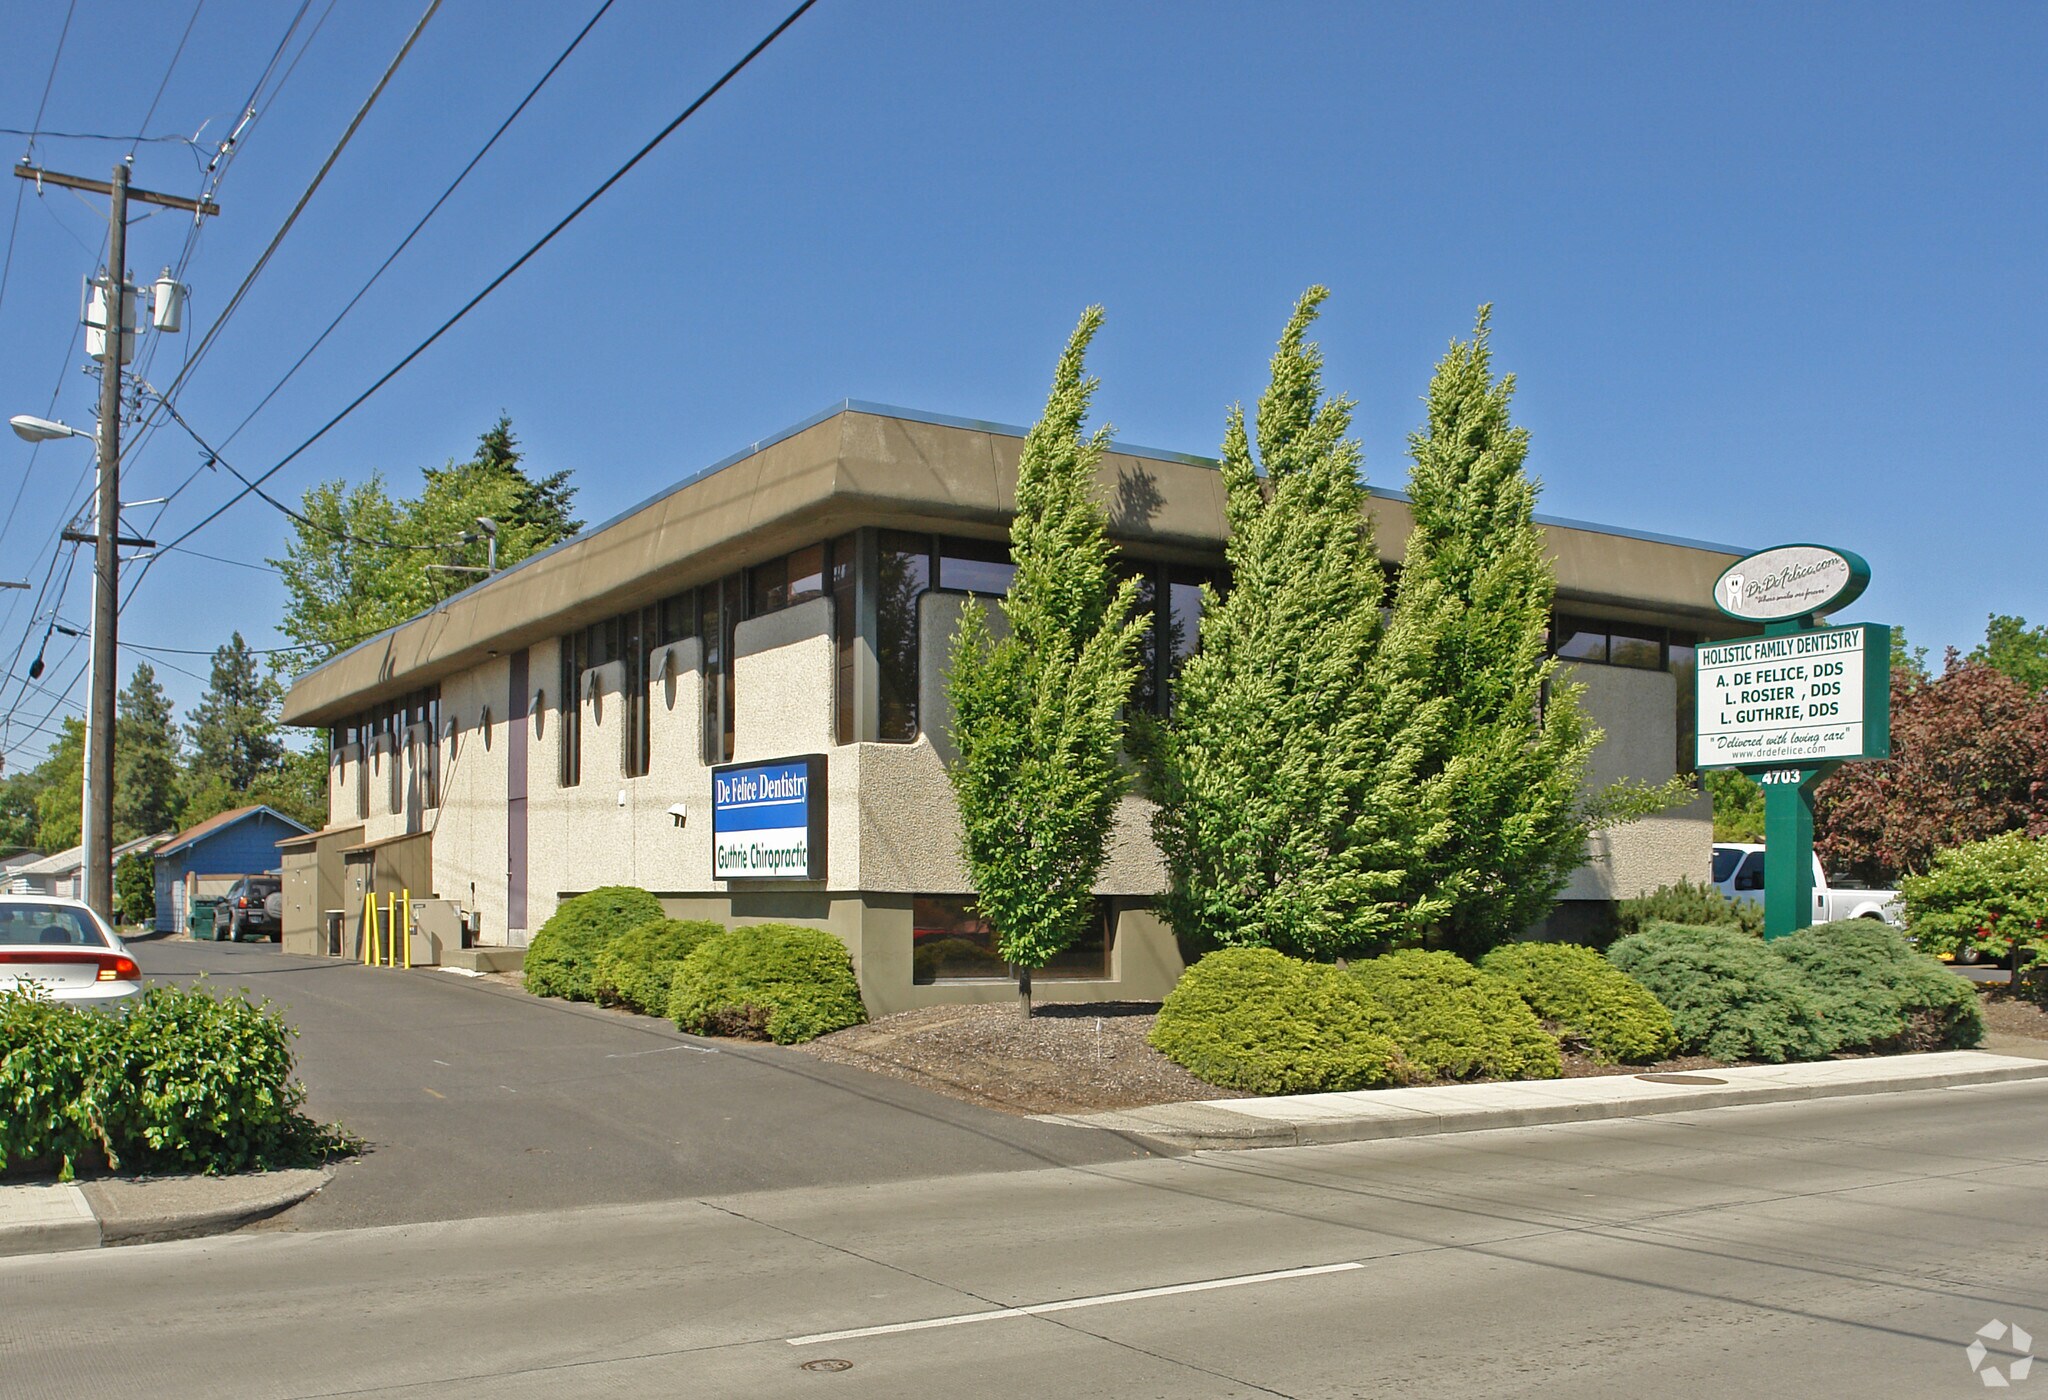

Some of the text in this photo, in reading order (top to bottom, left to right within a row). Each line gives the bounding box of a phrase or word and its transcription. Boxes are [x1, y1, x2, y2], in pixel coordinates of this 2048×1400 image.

[1703, 630, 1859, 666] HOLISTIC FAMILY DENTISTRY
[1716, 661, 1843, 688] A. DE FELICE, DDS
[1725, 692, 1736, 705] L.
[1741, 686, 1794, 704] ROSIER
[1811, 681, 1841, 697] DDS
[1720, 702, 1839, 725] L. GUTHRIE, DDS
[1766, 733, 1787, 745] with
[1790, 731, 1820, 746] loving
[1732, 744, 1826, 759] www.drdefelice.com
[717, 771, 807, 804] De Felice Dentistry
[1761, 769, 1801, 785] 4703
[717, 840, 807, 875] Guthrie Chiropractic
